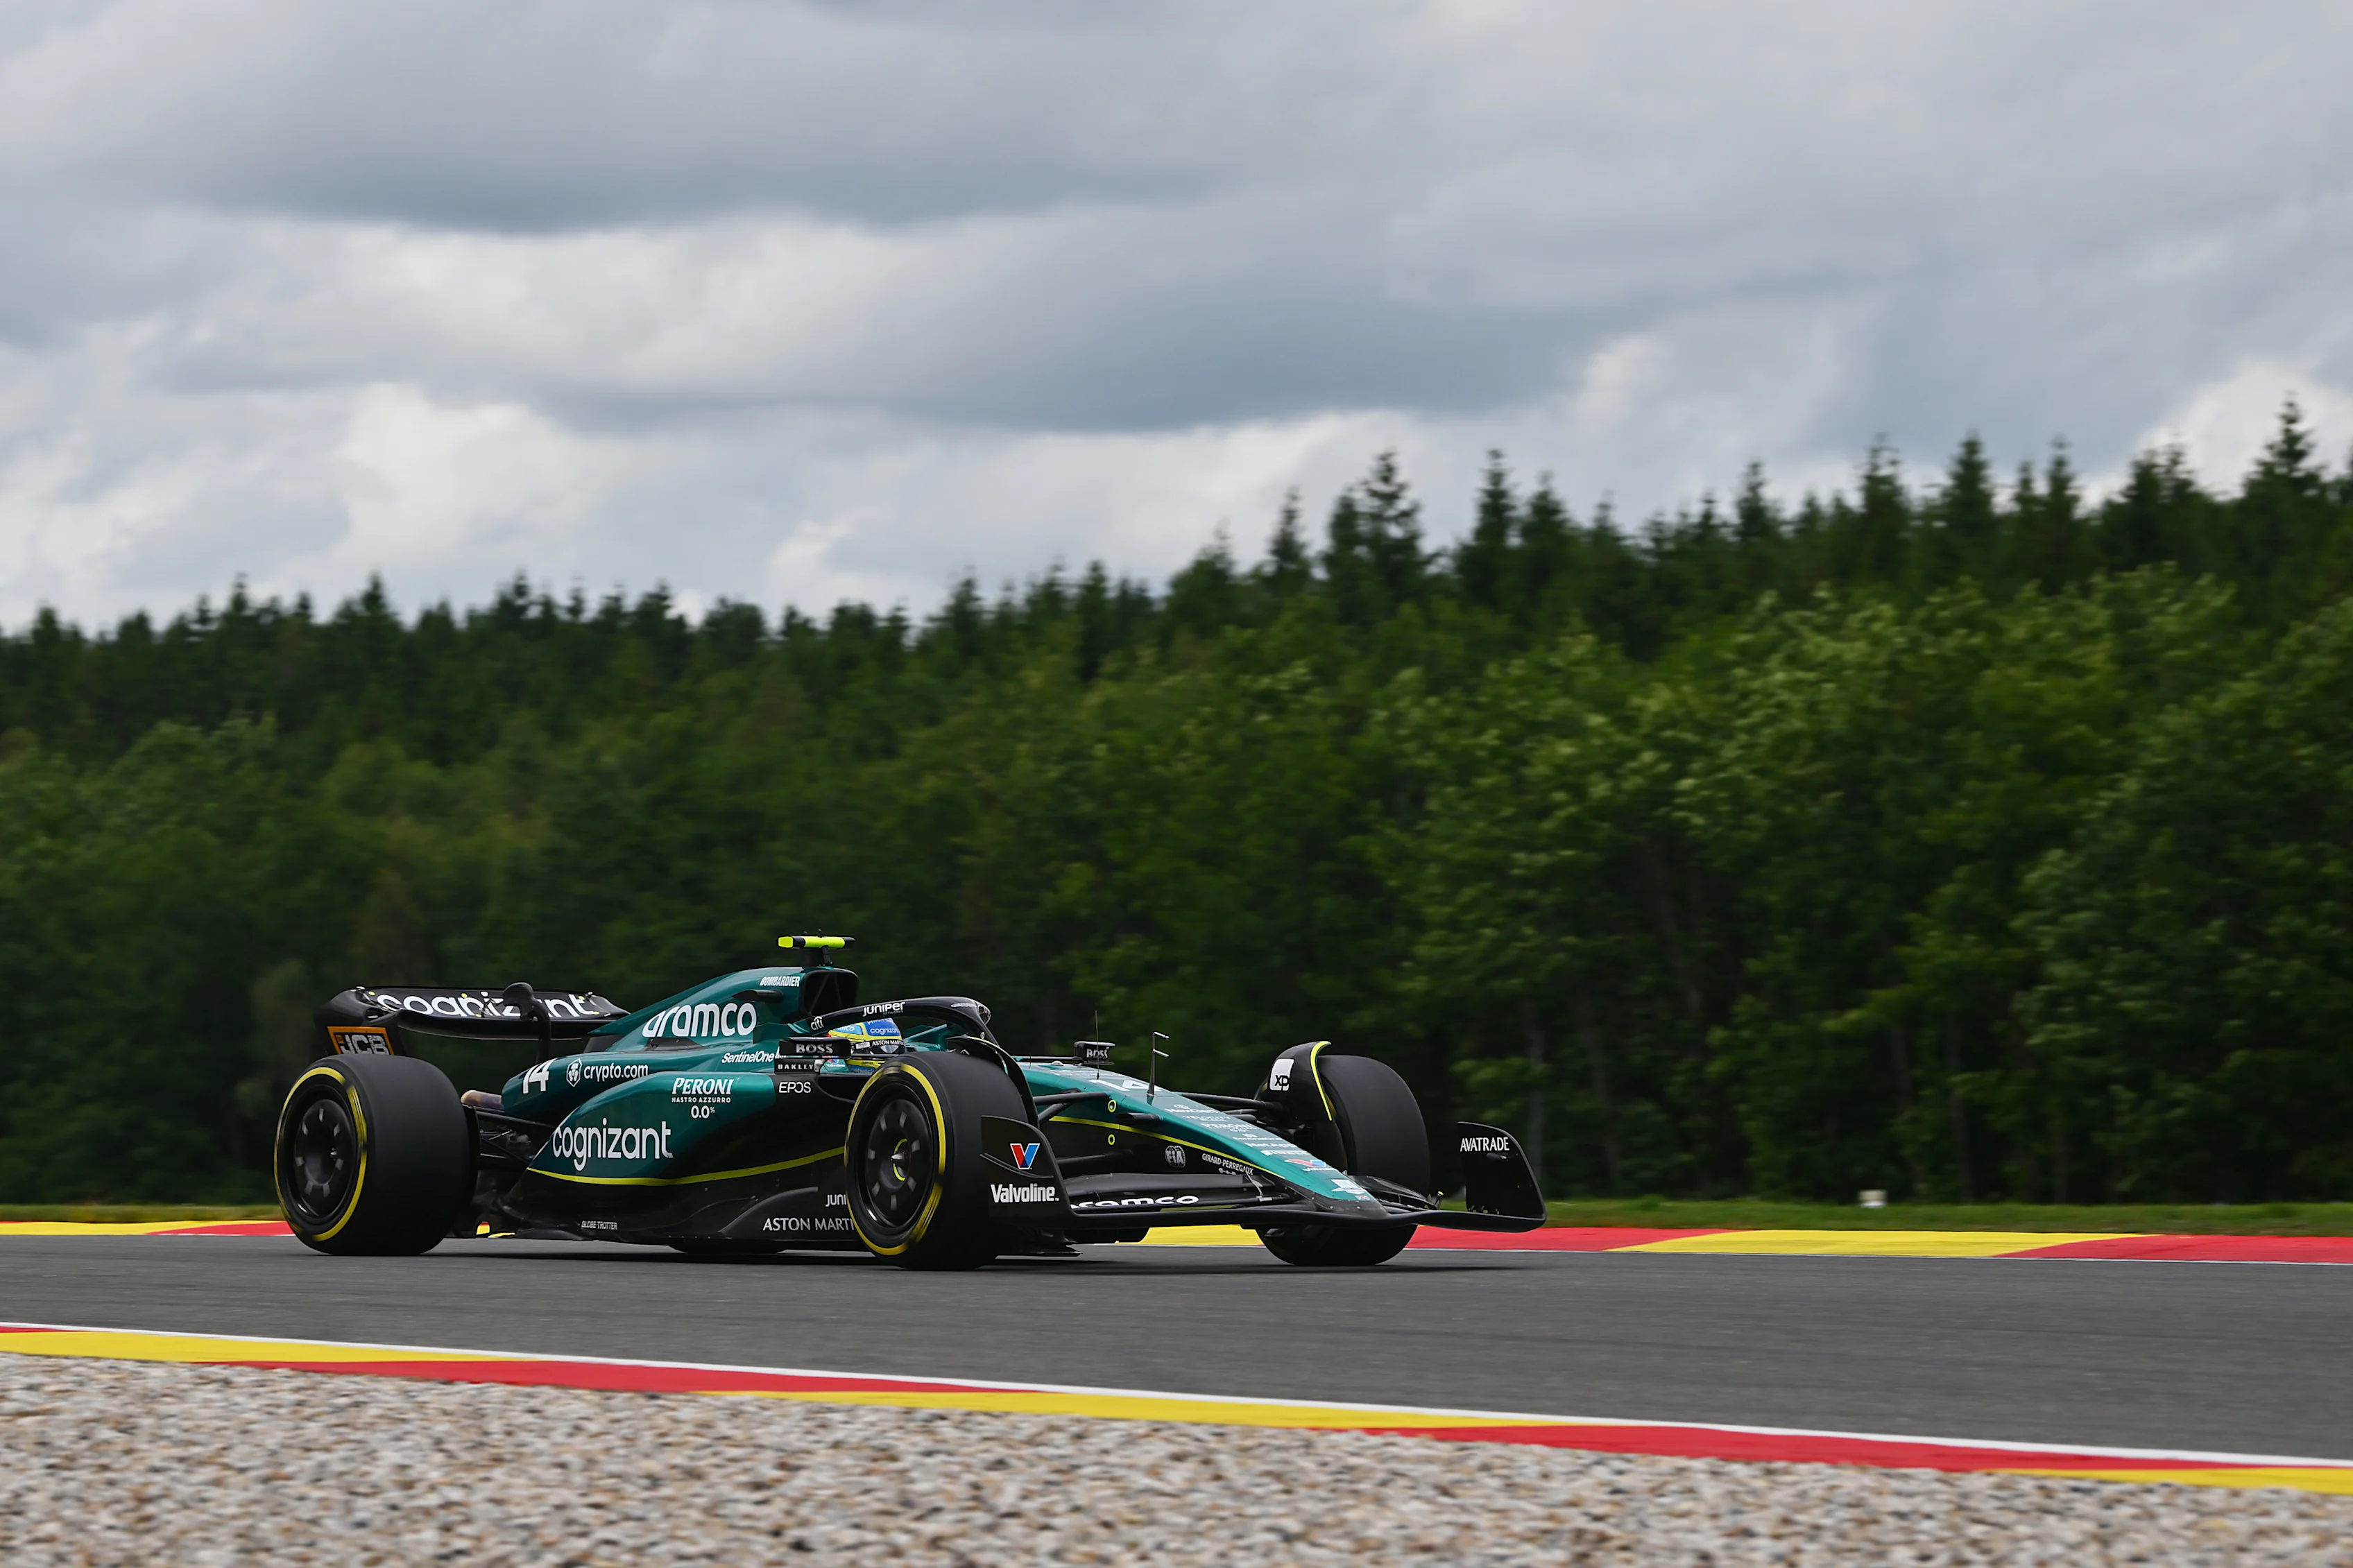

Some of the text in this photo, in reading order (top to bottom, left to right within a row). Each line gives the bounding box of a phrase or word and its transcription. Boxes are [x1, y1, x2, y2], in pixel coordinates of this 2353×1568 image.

[759, 976, 801, 988] BOMBARDIER
[642, 1003, 758, 1037] aramco
[811, 1016, 824, 1031] citi
[340, 1034, 390, 1055] JCB
[796, 1044, 833, 1053] BOSS
[721, 1051, 775, 1063] SentinelOne
[583, 1062, 649, 1082] crypto.com
[671, 1077, 735, 1095] PERONI
[778, 1081, 812, 1094] EPOS
[553, 1117, 674, 1171] cognizant
[1460, 1137, 1510, 1152] AVATRADE
[1201, 1153, 1254, 1175] GIRARD-PERREGAUX
[991, 1183, 1056, 1203] Valvoline
[1070, 1196, 1199, 1209] ramco
[581, 1220, 618, 1230] GLOBE-TROTTER
[762, 1217, 855, 1231] ASTON MARTI
